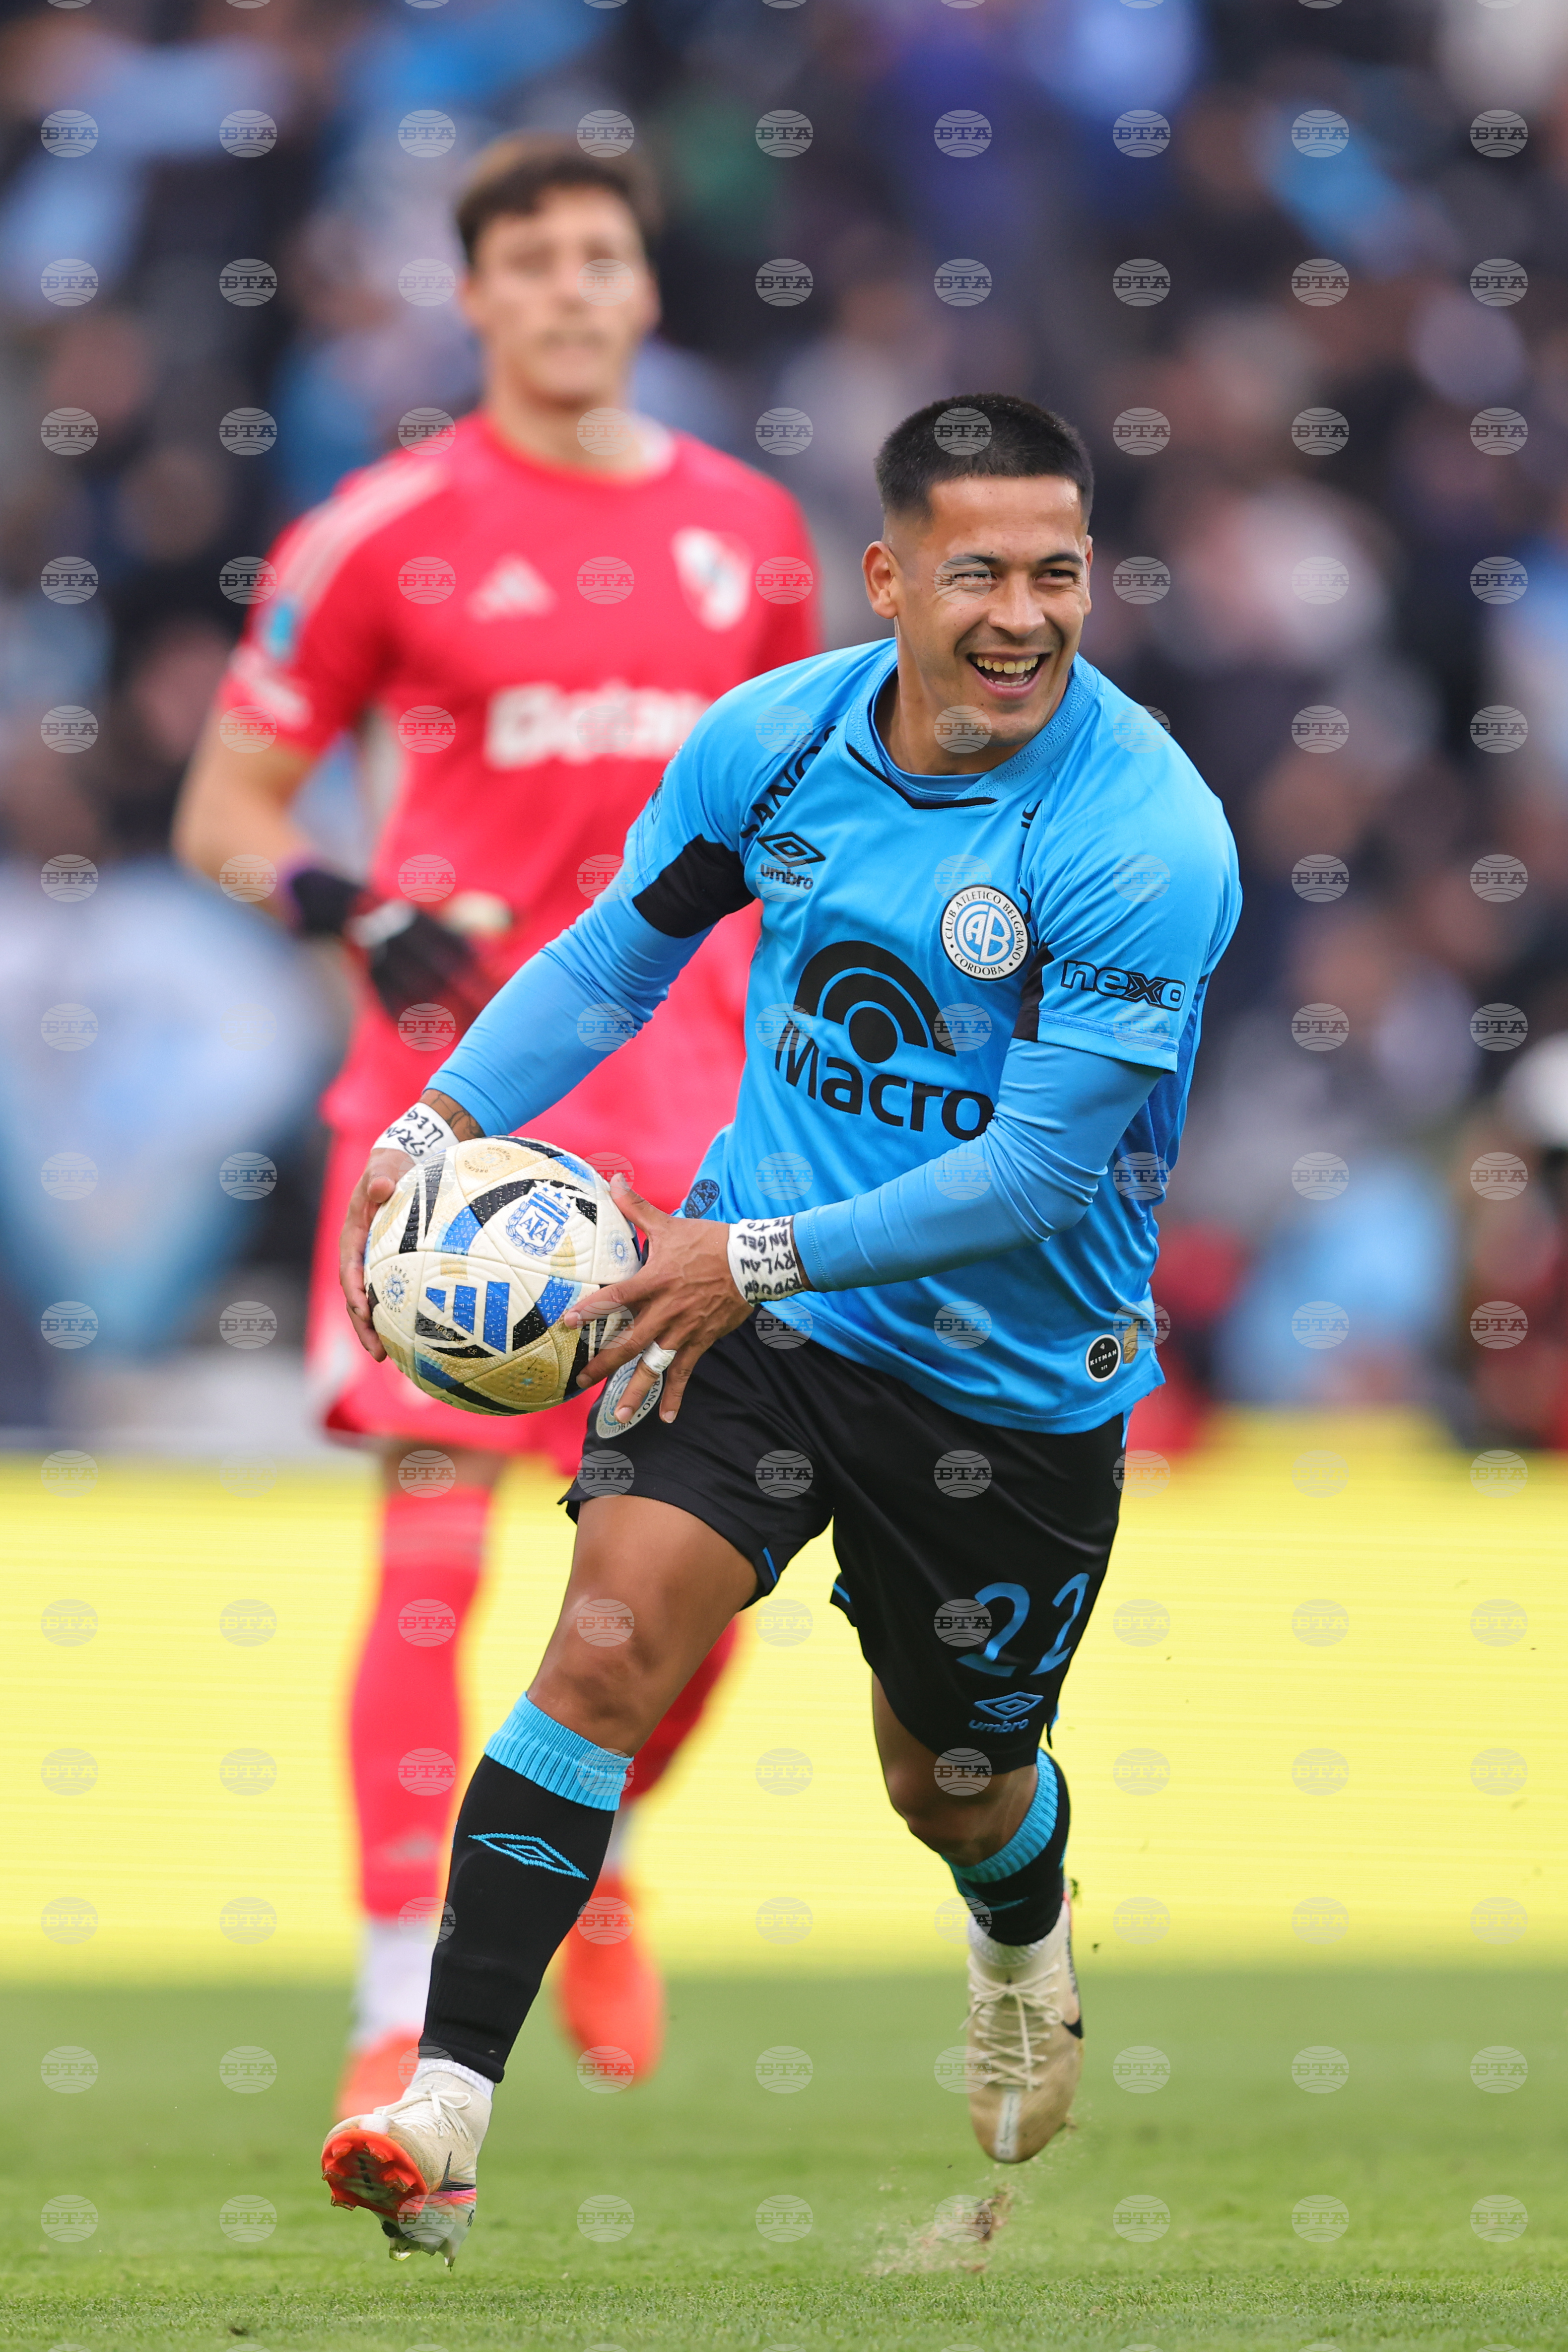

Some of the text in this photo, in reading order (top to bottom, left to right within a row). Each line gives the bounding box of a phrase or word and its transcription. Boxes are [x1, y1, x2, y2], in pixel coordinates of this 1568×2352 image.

[760, 864, 814, 890] umbro
[945, 891, 1024, 961] CLUB ATLETICO BELGRANO
[954, 953, 1005, 975] CORDOBA
[1061, 960, 1186, 1012] nexo
[775, 1019, 994, 1141] Macro
[737, 1229, 788, 1255] ANGEL
[390, 1265, 409, 1284] TANGO
[740, 1250, 796, 1275] RYLAN
[1090, 1349, 1117, 1366] KITMAN
[956, 1572, 1090, 1677] 22
[968, 1719, 1029, 1733] umbro
